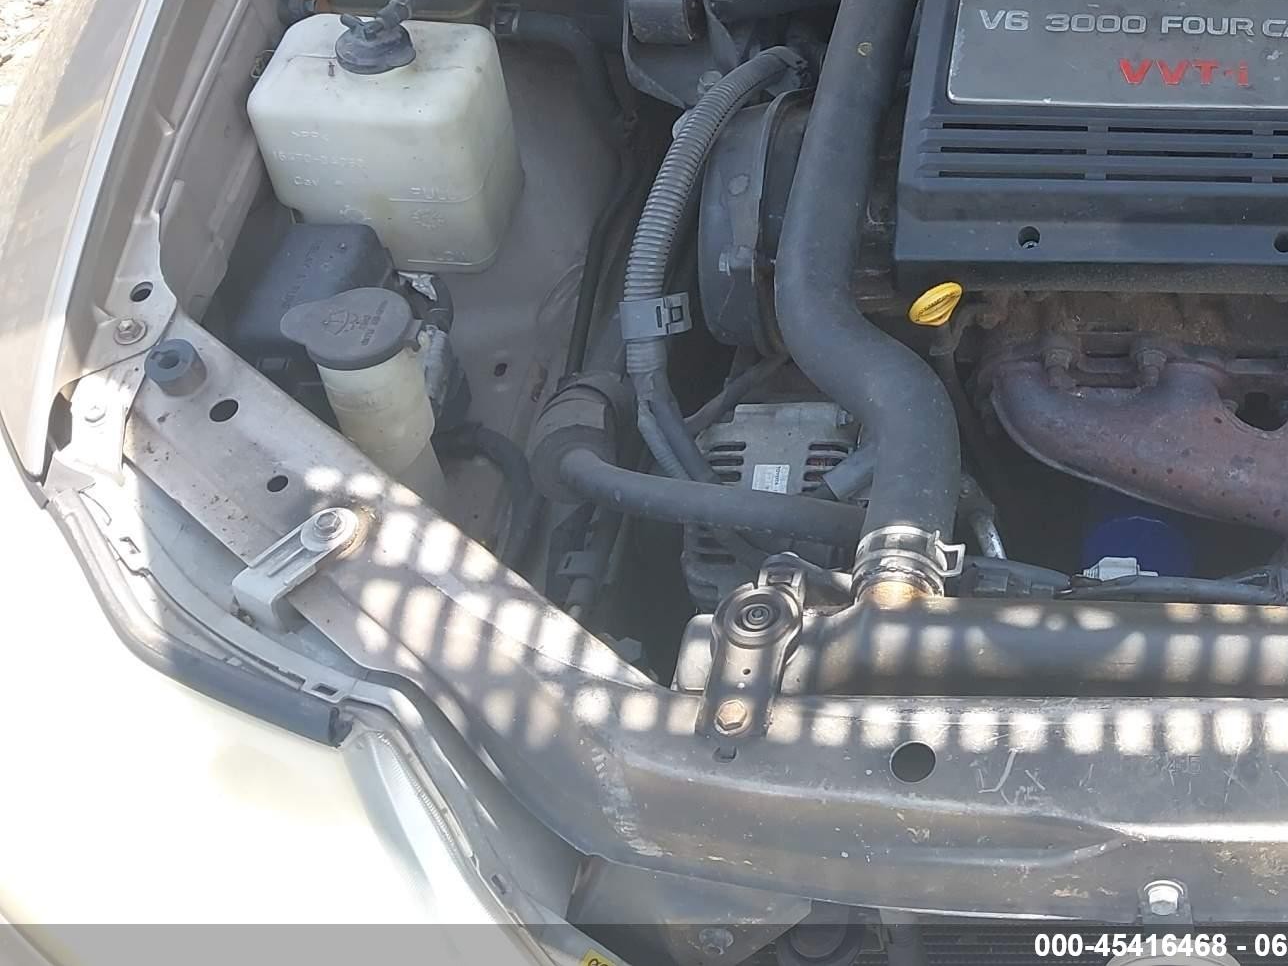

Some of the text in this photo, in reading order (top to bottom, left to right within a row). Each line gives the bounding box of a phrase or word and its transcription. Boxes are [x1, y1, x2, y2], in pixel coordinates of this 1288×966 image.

[978, 9, 1030, 31] V6
[1044, 13, 1147, 34] 3000
[1160, 15, 1255, 36] FOUR
